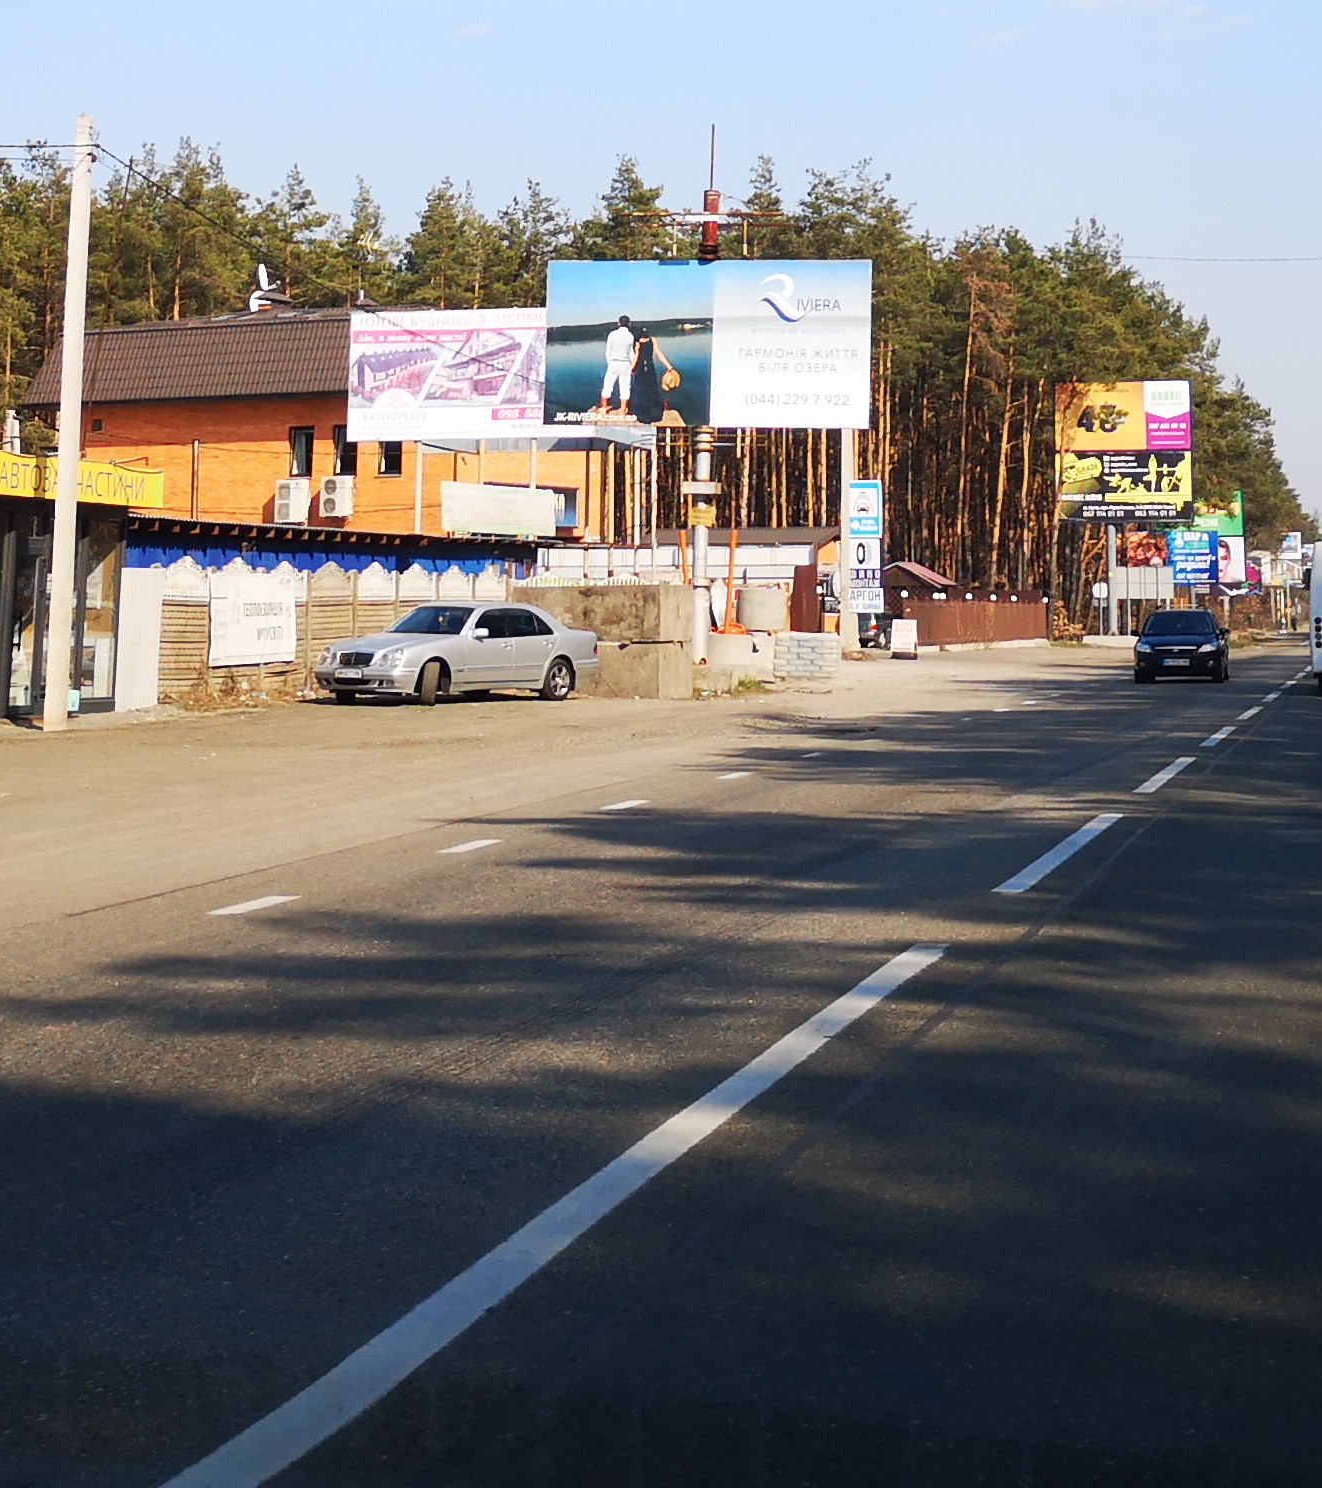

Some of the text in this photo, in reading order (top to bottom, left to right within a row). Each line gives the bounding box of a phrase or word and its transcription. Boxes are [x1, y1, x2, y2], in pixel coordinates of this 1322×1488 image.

[411, 314, 475, 327] БУДИНКИ
[479, 314, 487, 325] В
[738, 348, 858, 359] ГАРМОНІЯ ЖИТТЯ
[759, 363, 838, 373] БІЛЯ ОЗЕРА
[744, 393, 850, 407] (044) 229 7 922
[497, 408, 520, 419] 098
[850, 589, 881, 601] АРГОН
